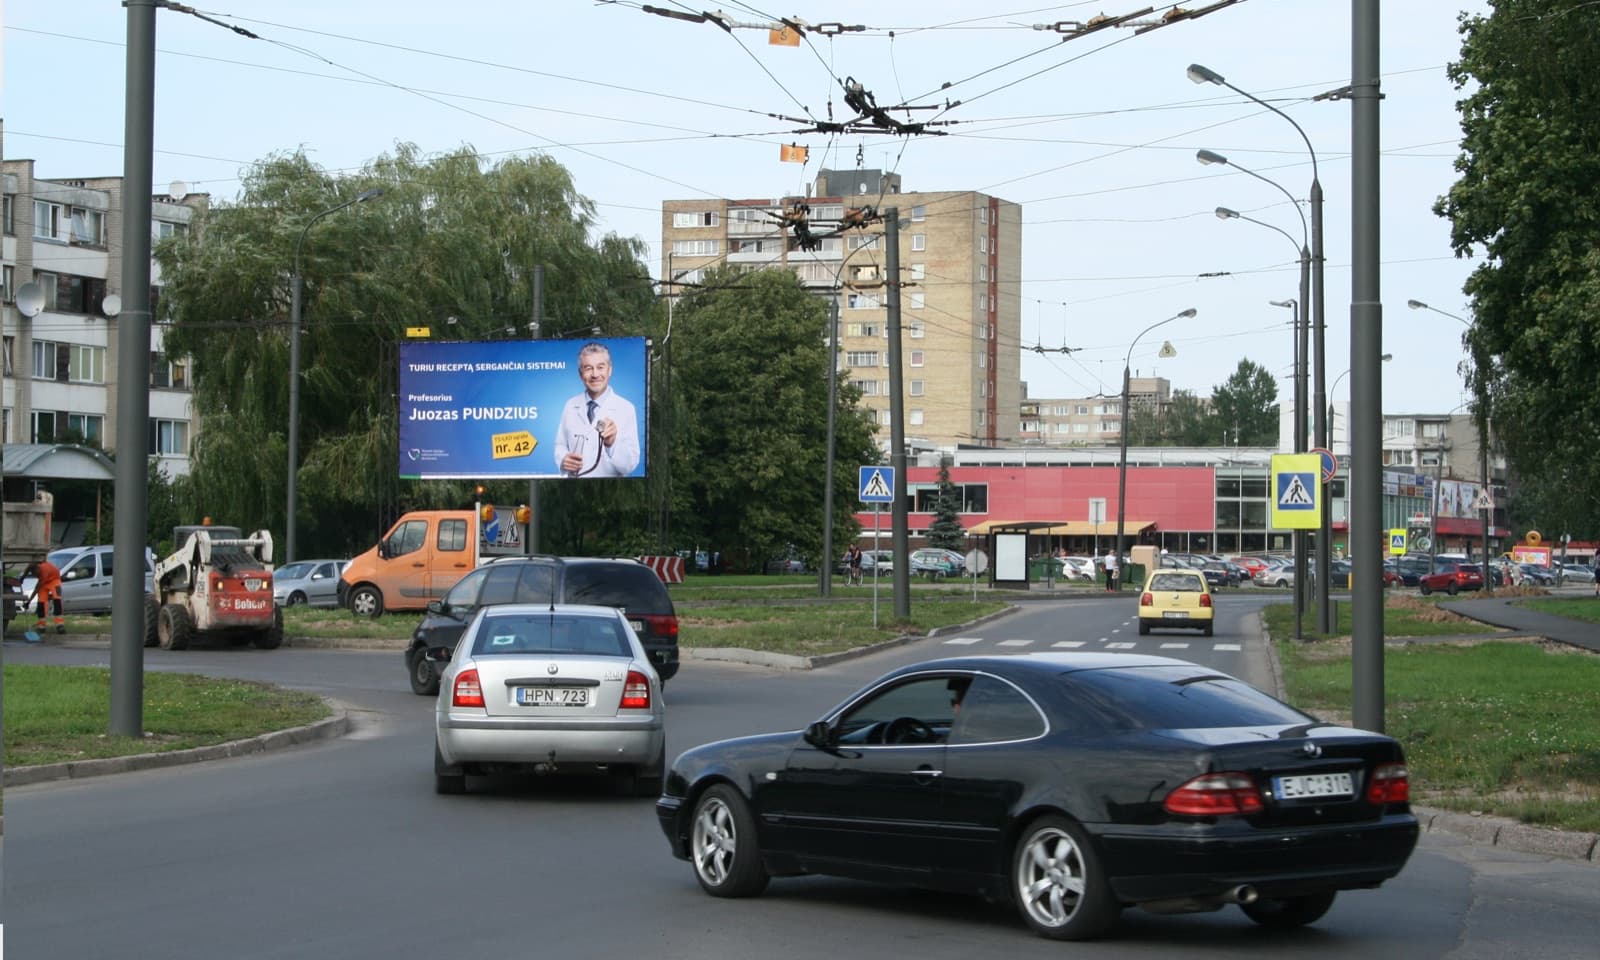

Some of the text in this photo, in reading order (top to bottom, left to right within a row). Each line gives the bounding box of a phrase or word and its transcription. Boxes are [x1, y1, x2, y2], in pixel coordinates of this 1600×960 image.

[409, 361, 566, 373] TURIU RECEPTĄ SERGANČIAI SISTEMAI
[408, 394, 452, 402] Profesorius
[409, 406, 538, 420] Juozas PUNDZIUS
[495, 440, 530, 454] nr. 42
[524, 689, 587, 702] HPN 723
[1283, 776, 1316, 797] EJC
